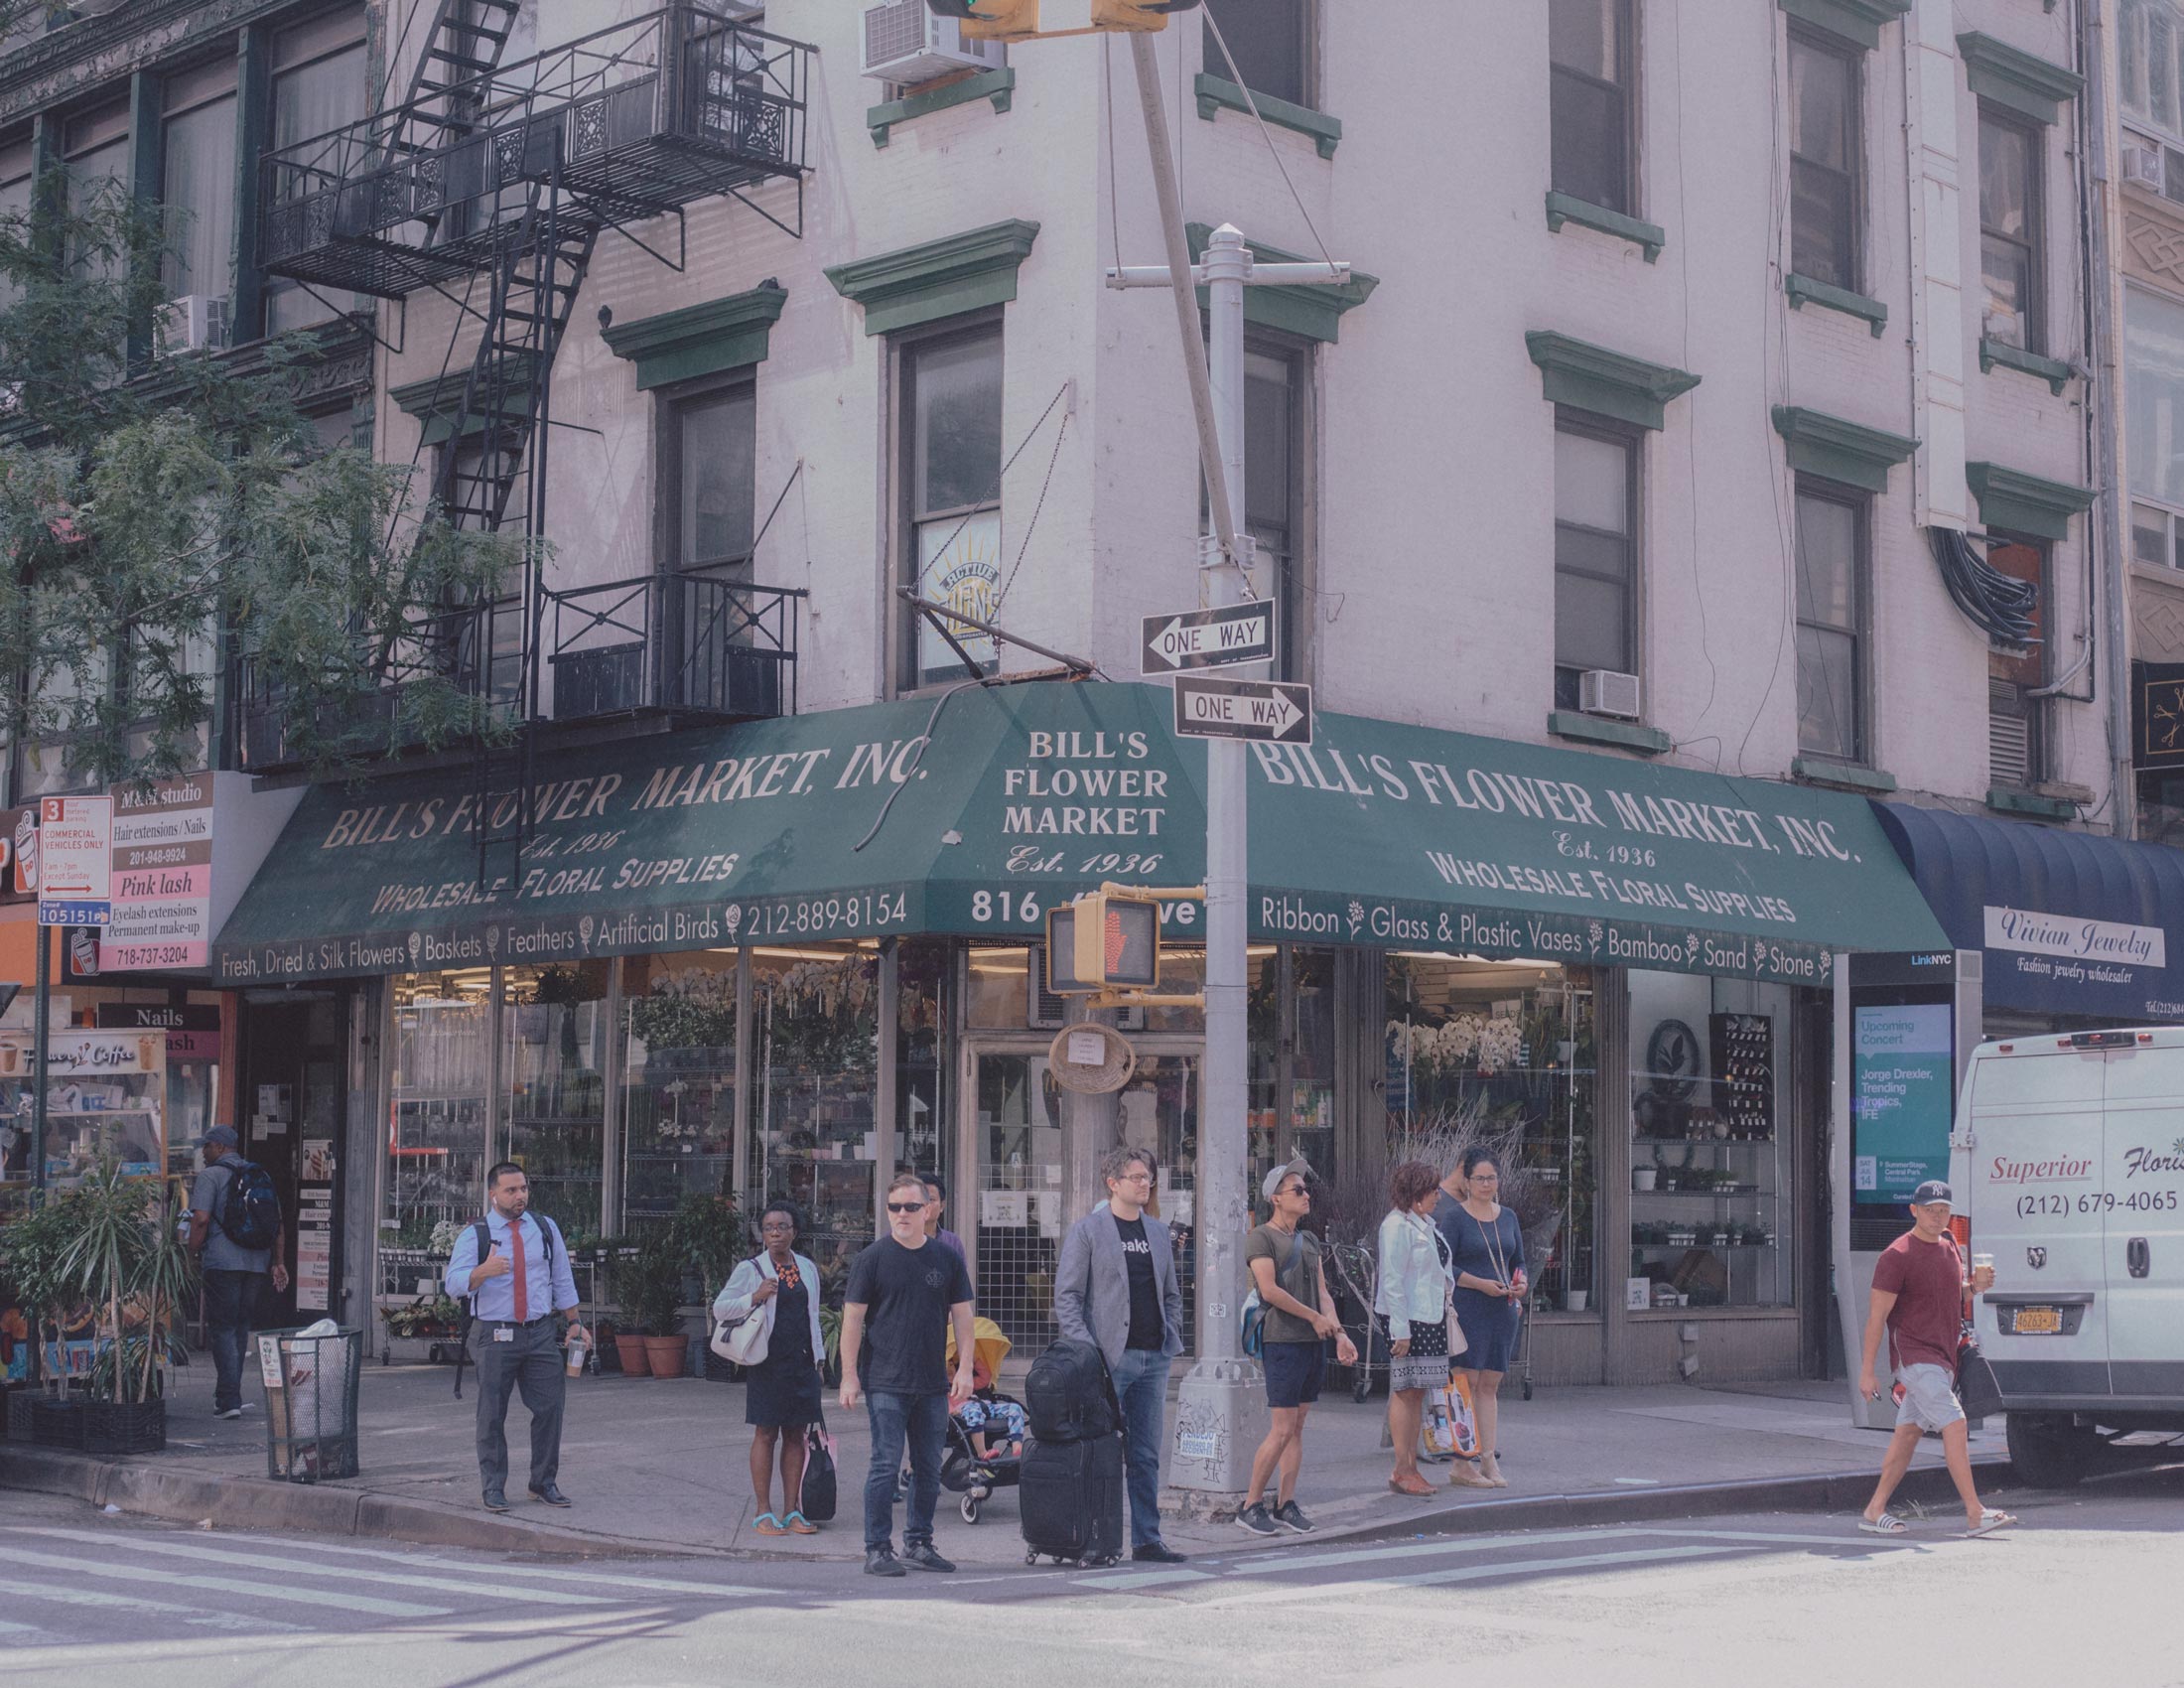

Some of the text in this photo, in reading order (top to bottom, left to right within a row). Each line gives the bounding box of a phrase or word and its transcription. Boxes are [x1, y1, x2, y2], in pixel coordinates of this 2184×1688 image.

[946, 562, 997, 592] ACTIVE
[1163, 621, 1258, 654] ONE WAY
[1195, 696, 1291, 725] ONE WAY
[1029, 731, 1149, 759] BILL'S
[161, 782, 203, 804] studio
[321, 797, 445, 849] BILL'S
[834, 735, 931, 789] INC.
[1004, 769, 1168, 797] FLOWER
[47, 800, 60, 820] 3
[1251, 741, 1862, 864] BILL'S FLOWER MARKET, INC.
[45, 829, 95, 839] COMMERCIAL
[113, 824, 133, 842] Hair
[134, 821, 178, 840] extensions
[184, 817, 206, 835] Nails
[1002, 806, 1165, 835] MARKET
[45, 840, 103, 850] VEHICLES ONLY
[563, 828, 625, 856] 1936
[1552, 830, 1656, 868] Est. 1936
[129, 847, 187, 866] 201-948-9924
[1006, 845, 1163, 874] Est. 1936
[120, 872, 193, 897] Pink lash
[370, 853, 739, 914] WHOLESALE FLORAL SUPPLIES
[1426, 851, 1796, 923] WHOLESALE FLORAL SUPPLIES
[42, 909, 92, 923] 105151
[113, 903, 198, 923] Eyelash extensions
[748, 892, 906, 935] 212-889-8154
[971, 890, 1040, 922] 816
[1159, 900, 1195, 924] ve
[1262, 897, 1339, 933] Ribbon
[108, 920, 201, 937] Permanent make-up
[508, 921, 574, 953] Feathers
[597, 907, 719, 946] Artificial Birds
[1370, 905, 1582, 953] Glass & Plastic Vases
[2001, 911, 2152, 962] Vivian Jewelry
[117, 946, 188, 965] 718-737-3204
[222, 938, 404, 978] Fresh, Dried & Silk Flowers
[425, 929, 481, 961] Baskets
[1608, 927, 1682, 962] Bamboo
[1705, 938, 1747, 970] Sand
[1770, 945, 1814, 977] Stone
[1911, 954, 1953, 966] LinkNYC
[2017, 956, 2133, 984] Fashion jewelry wholesaler
[136, 1008, 184, 1027] Nails
[1861, 1020, 1915, 1033] Upcoming
[166, 1034, 195, 1051] ash
[1861, 1034, 1904, 1046] Concert
[91, 1045, 135, 1066] Coffee
[1861, 1068, 1934, 1082] Jorge Drexler,
[1861, 1081, 1907, 1095] Trending
[1861, 1095, 1903, 1108] Tropics,
[1860, 1175, 1871, 1187] 14
[1988, 1154, 2093, 1185] Superior
[2016, 1191, 2178, 1219] (212) 679-4065
